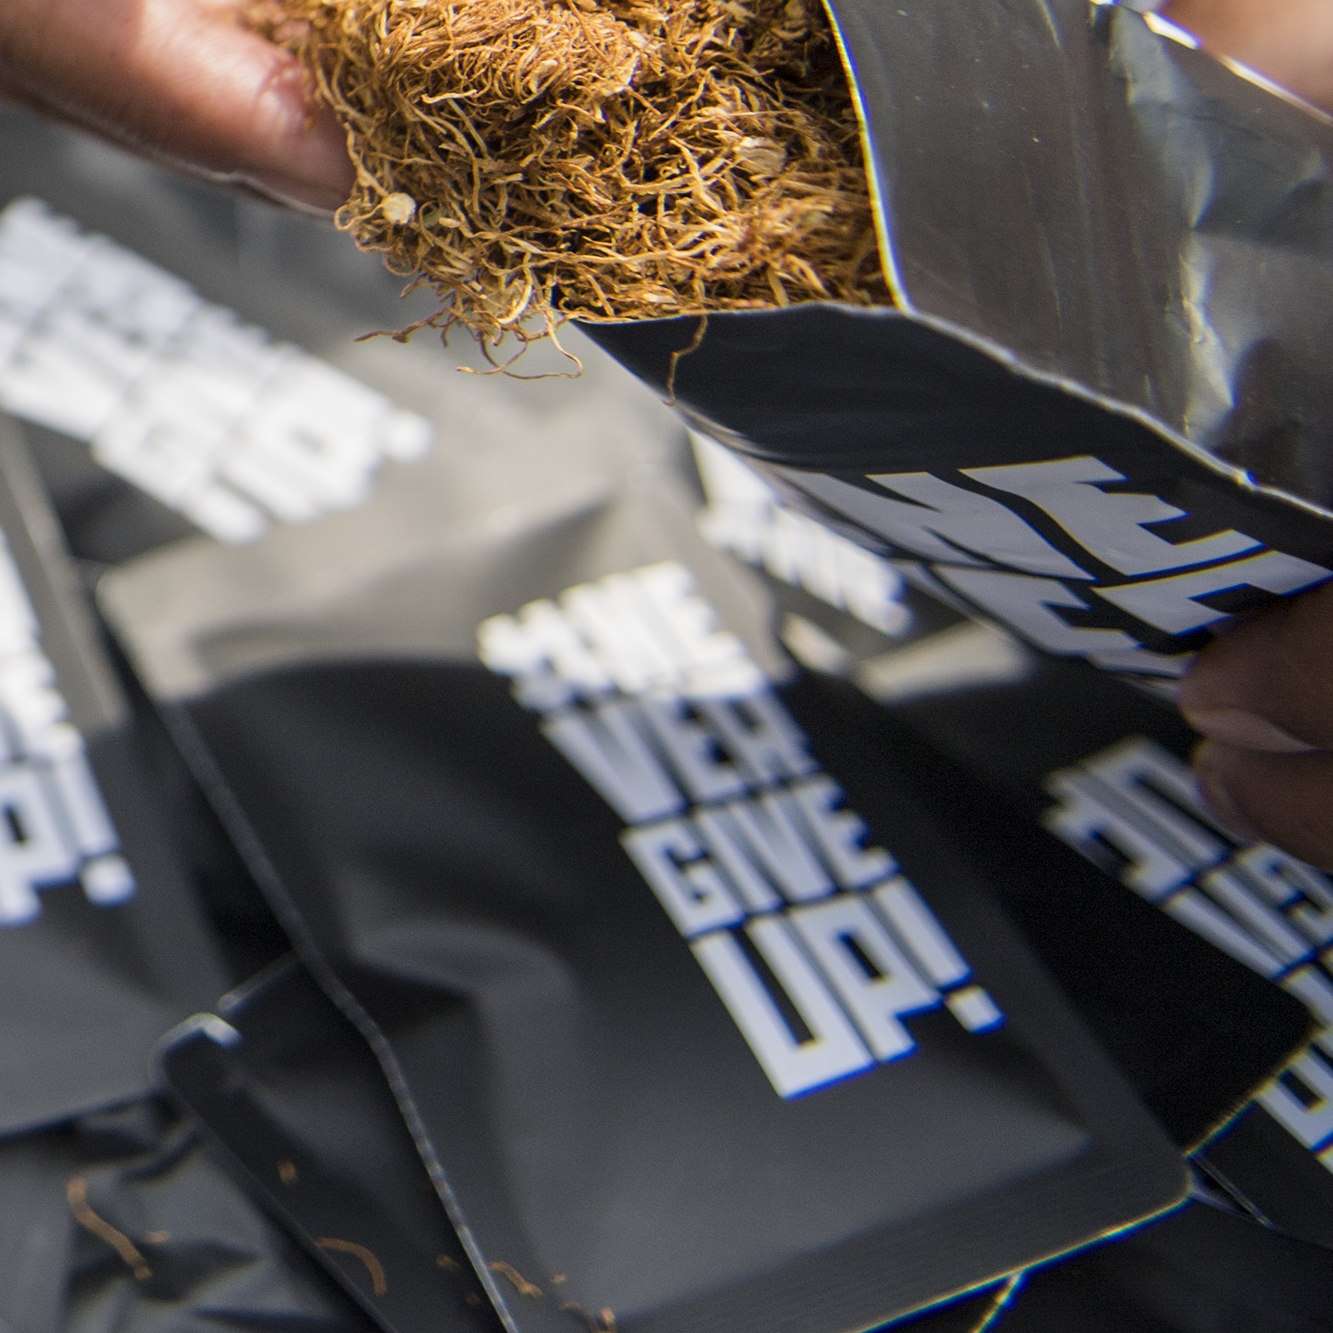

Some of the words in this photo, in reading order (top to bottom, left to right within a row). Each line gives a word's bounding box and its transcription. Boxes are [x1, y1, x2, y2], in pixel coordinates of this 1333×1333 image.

[539, 656, 823, 824] VER
[620, 772, 903, 939] GIVE
[690, 874, 1006, 1100] UP!
